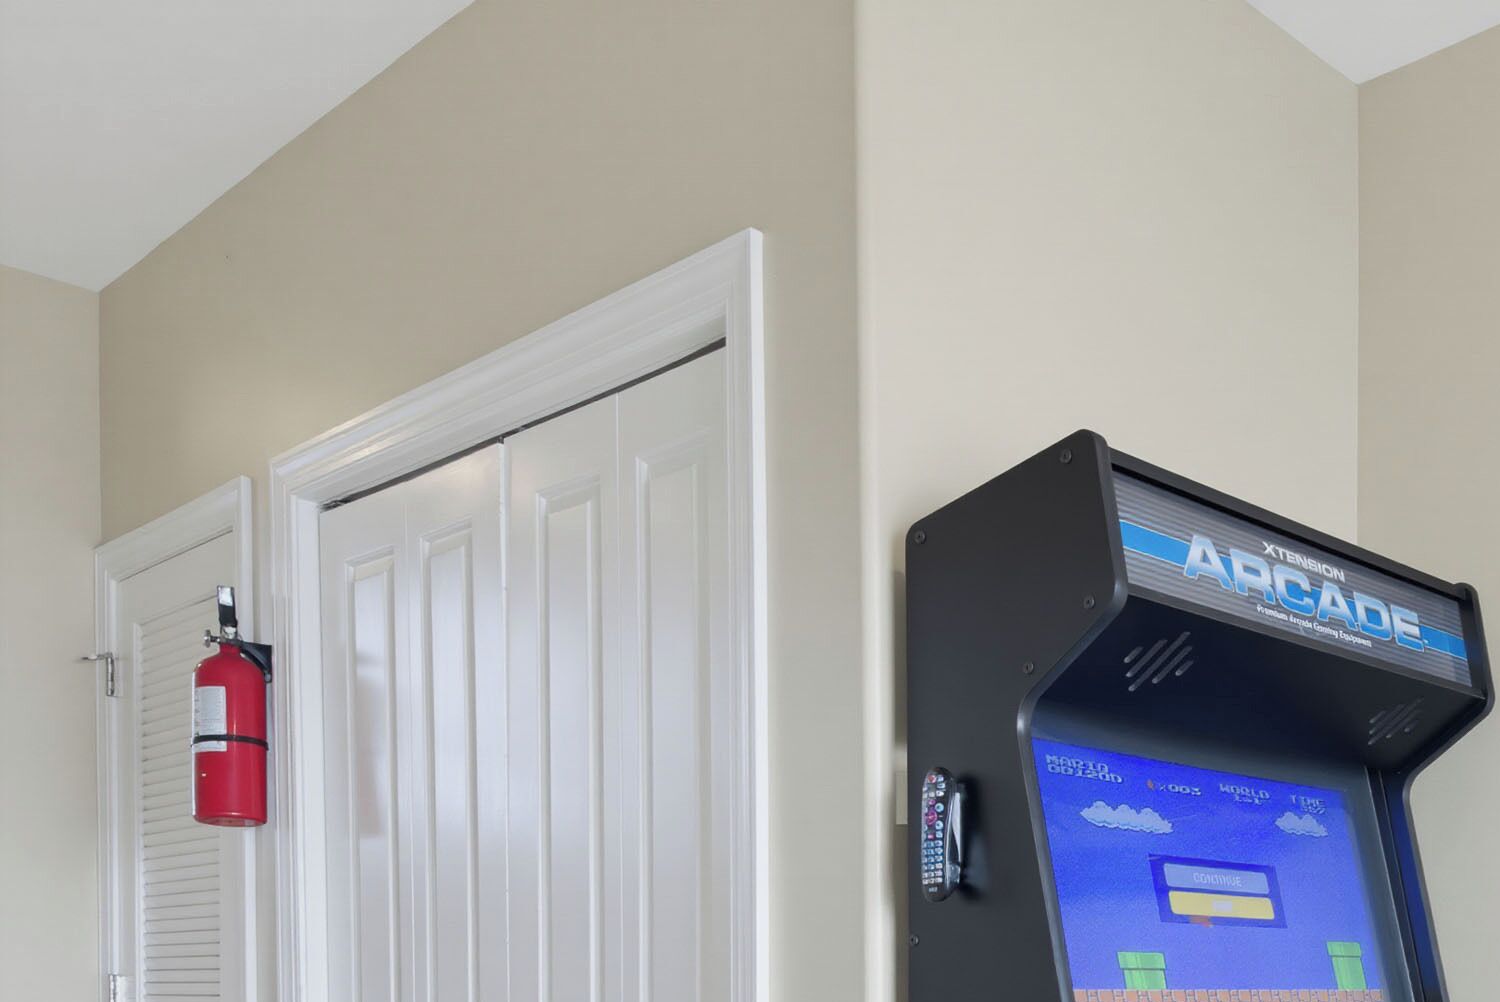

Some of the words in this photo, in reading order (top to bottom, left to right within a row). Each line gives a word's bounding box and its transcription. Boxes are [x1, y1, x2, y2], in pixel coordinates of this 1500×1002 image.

[1262, 541, 1345, 583] XTENSION
[1183, 534, 1425, 653] ARCADE
[1045, 754, 1109, 773] MARIO
[1219, 783, 1270, 800] WORLD
